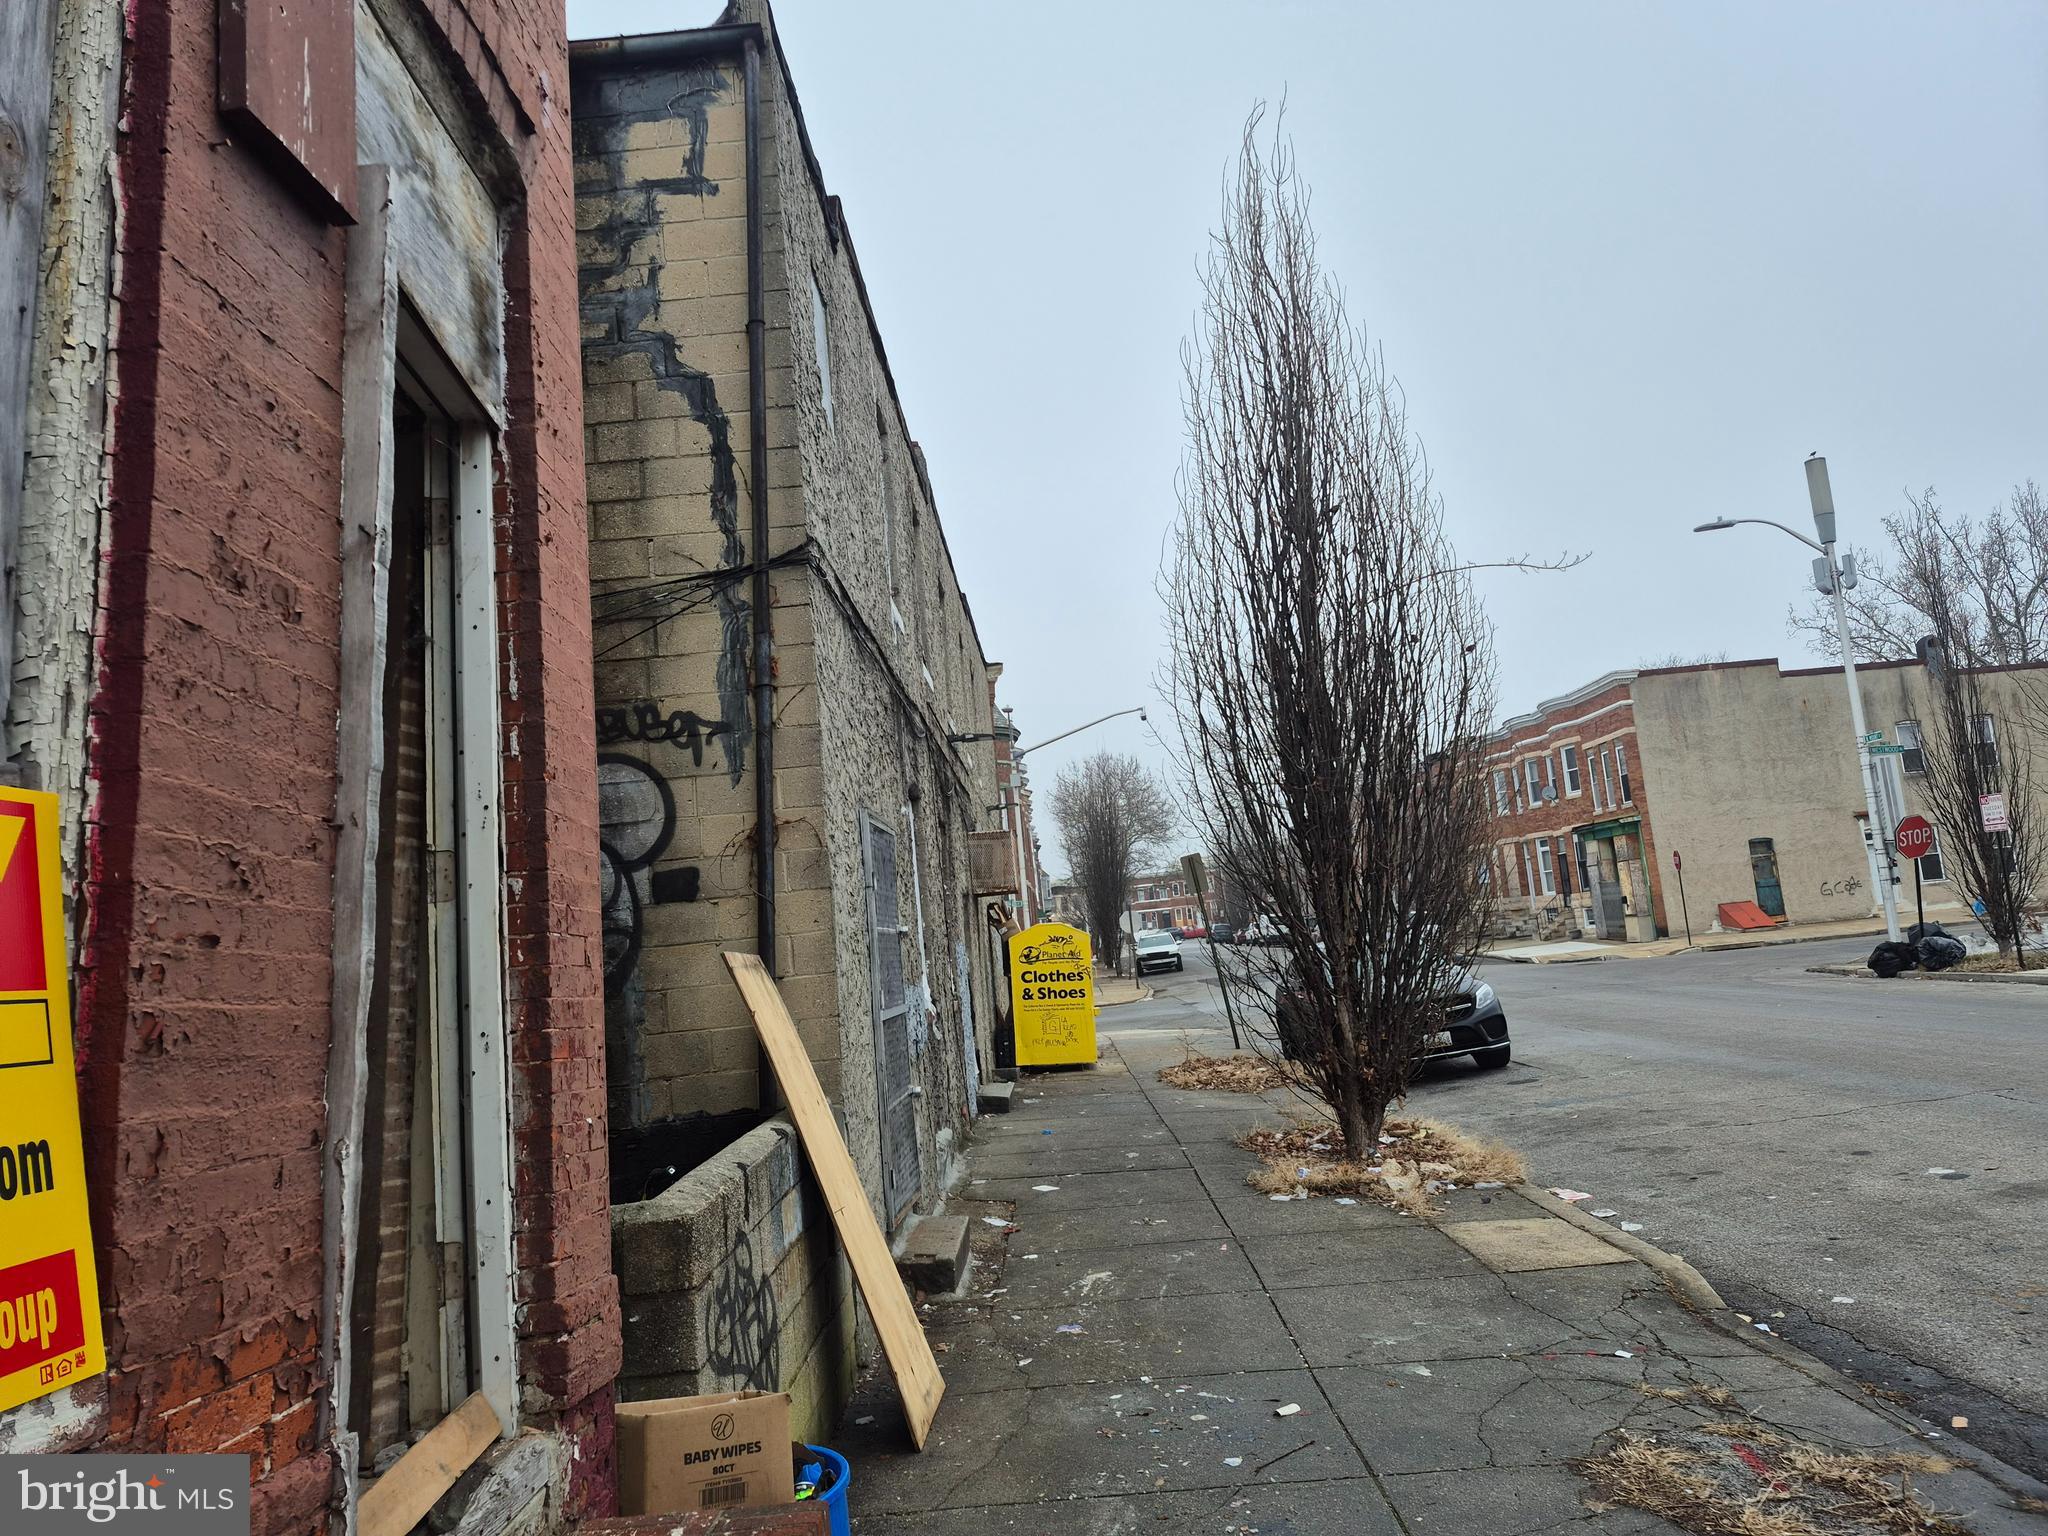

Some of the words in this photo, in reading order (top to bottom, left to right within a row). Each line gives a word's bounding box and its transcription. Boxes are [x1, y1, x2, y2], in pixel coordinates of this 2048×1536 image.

[1899, 827, 1931, 847] STOP
[1021, 970, 1085, 983] Clothes
[1021, 987, 1034, 1001] &
[1037, 986, 1086, 1000] Shoes
[684, 1447, 719, 1466] BABY
[720, 1440, 762, 1459] WIPES
[712, 1463, 735, 1476] 80CT
